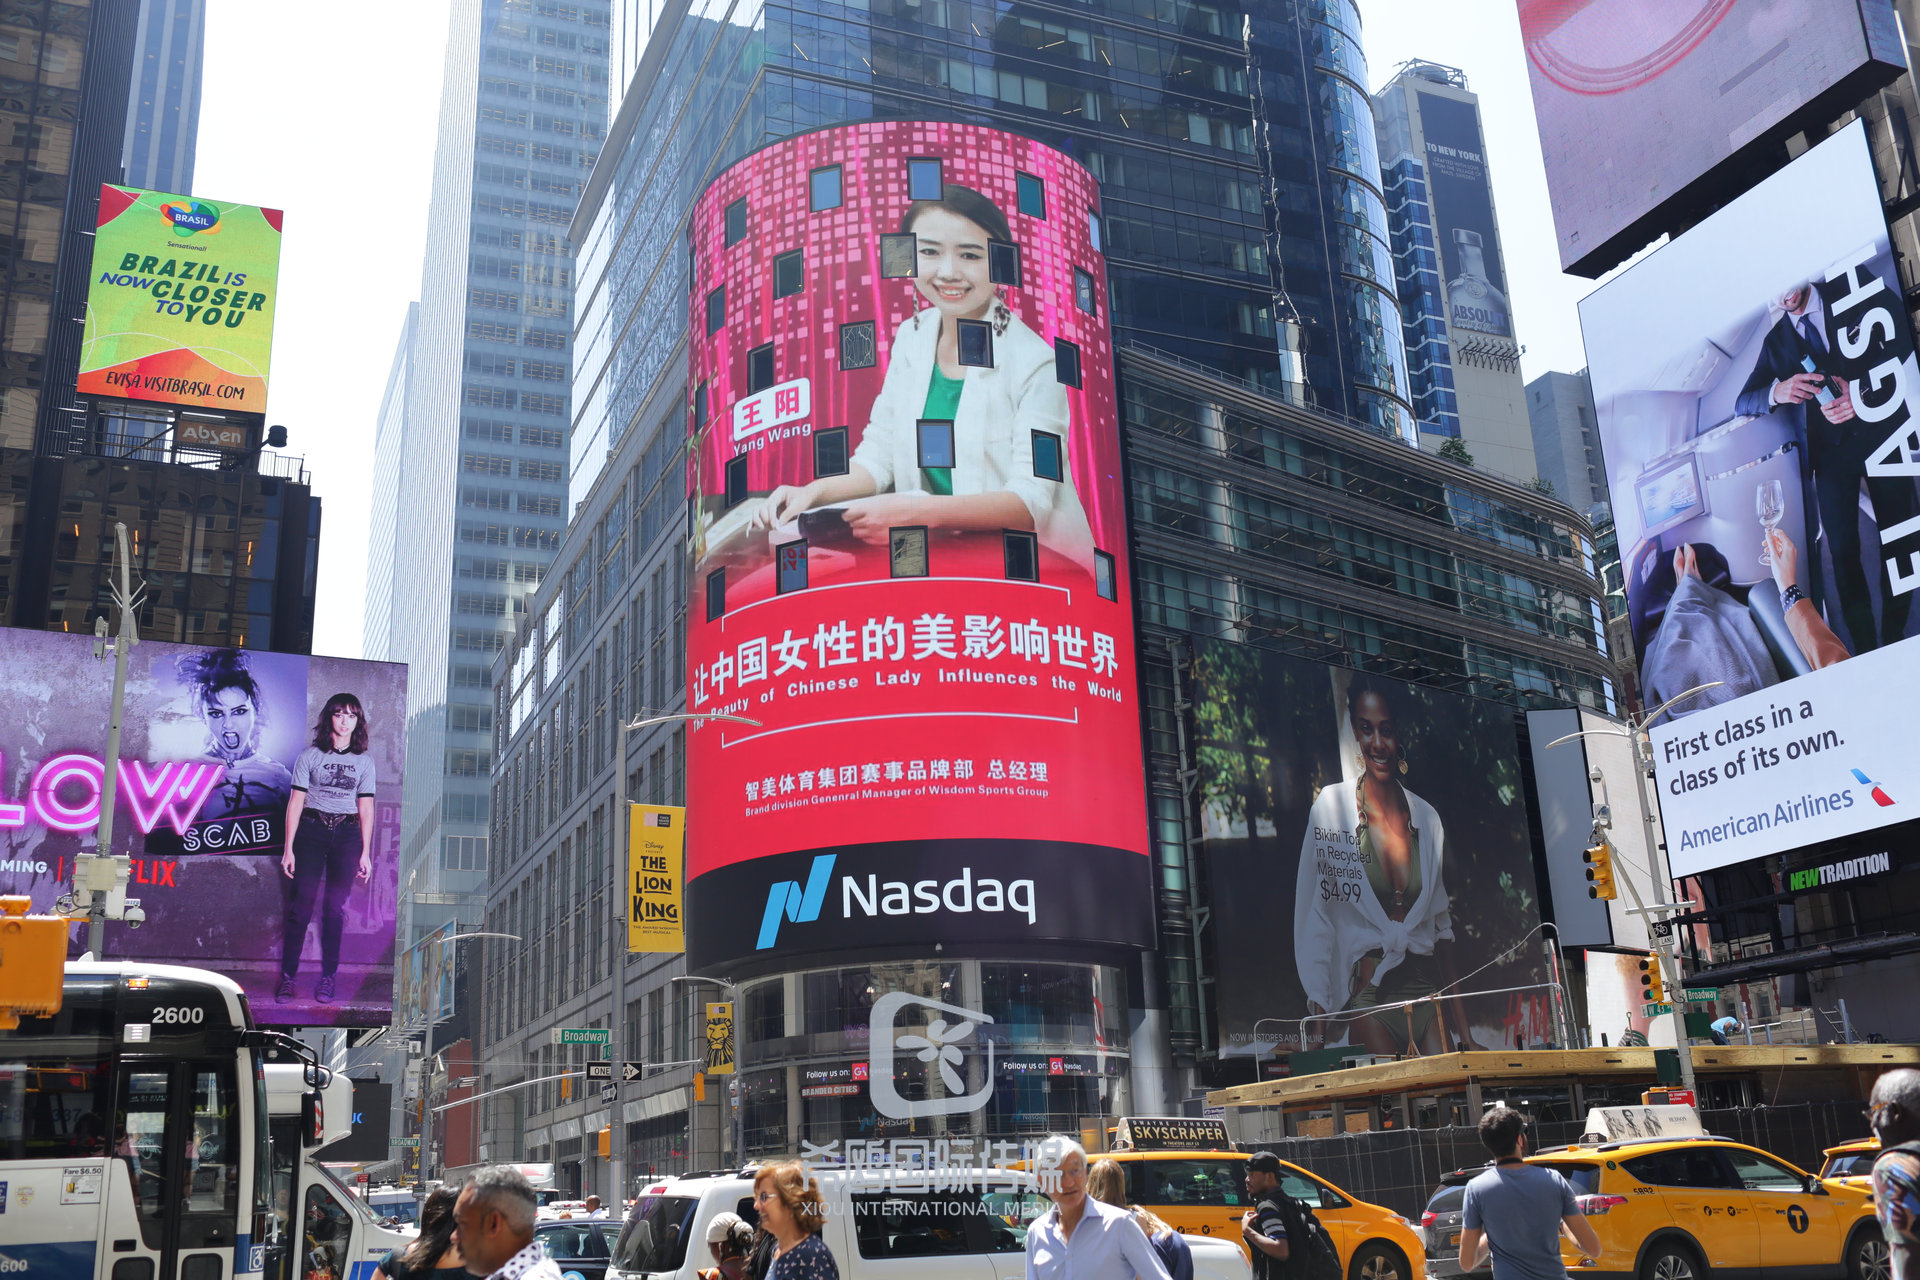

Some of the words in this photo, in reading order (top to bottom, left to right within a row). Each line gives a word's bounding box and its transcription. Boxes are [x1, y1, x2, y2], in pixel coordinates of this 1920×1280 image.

[1426, 142, 1437, 153] TO
[1438, 145, 1456, 157] NEW
[175, 213, 209, 226] BRASIL
[119, 252, 221, 284] BRAZIL
[223, 271, 247, 287] IS
[99, 271, 156, 290] NOW
[151, 280, 267, 312] CLOSER
[156, 299, 185, 316] TO
[184, 303, 246, 329] YOU
[1454, 304, 1504, 326] ABSOL
[741, 386, 800, 432] 王阳
[182, 426, 242, 445] Absen
[733, 436, 765, 456] Yang
[768, 423, 811, 444] Wang
[693, 612, 1119, 709] 让中国女性的美影响世界
[760, 687, 775, 703] of
[787, 676, 859, 697] Chinese
[875, 669, 921, 686] Lady
[938, 668, 1038, 686] Influences
[1051, 675, 1076, 691] the
[1087, 680, 1122, 703] World
[1663, 731, 1710, 764] First
[1714, 715, 1766, 747] class
[1770, 704, 1794, 729] in
[1799, 700, 1814, 720] a
[1669, 766, 1719, 796] class
[1724, 750, 1747, 779] of
[1751, 746, 1780, 771] its
[1786, 729, 1846, 760] own.
[745, 758, 974, 802] 智美体育集团赛事品牌部
[987, 759, 1049, 782] 总经理
[745, 803, 770, 817] Brand
[771, 798, 809, 811] division
[862, 788, 911, 799] Manager
[914, 786, 926, 795] of
[929, 785, 975, 794] Wisdom
[978, 784, 1015, 796] Sports
[1017, 786, 1049, 798] Group
[1680, 811, 1771, 852] American
[1773, 788, 1854, 827] Airlines
[183, 819, 272, 852] SCAB
[642, 840, 664, 851] Disney
[1314, 826, 1340, 844] Bikini
[1342, 830, 1362, 848] Top
[640, 855, 667, 869] THE
[1316, 844, 1325, 858] in
[1327, 845, 1372, 865] Recycled
[1317, 861, 1363, 880] Materials
[636, 871, 672, 894] LION
[1320, 878, 1362, 903] $4.99
[841, 866, 1037, 926] Nasdaq
[633, 895, 678, 922] KING
[1687, 990, 1717, 1000] Broadway
[152, 1007, 204, 1024] 2600
[1648, 1005, 1655, 1015] W
[564, 1031, 608, 1044] Broadway
[1229, 1033, 1247, 1041] NOW
[1256, 1033, 1283, 1042] STORES
[594, 1067, 610, 1075] ONE
[806, 1070, 828, 1079] Follow
[1003, 1062, 1027, 1070] Follow
[801, 1086, 833, 1096] BRANDED
[833, 1085, 858, 1094] CITIES
[391, 1138, 418, 1146] BROADWAY
[1134, 1127, 1224, 1140] SKYSCRAPER
[80, 1167, 102, 1175] $6.50
